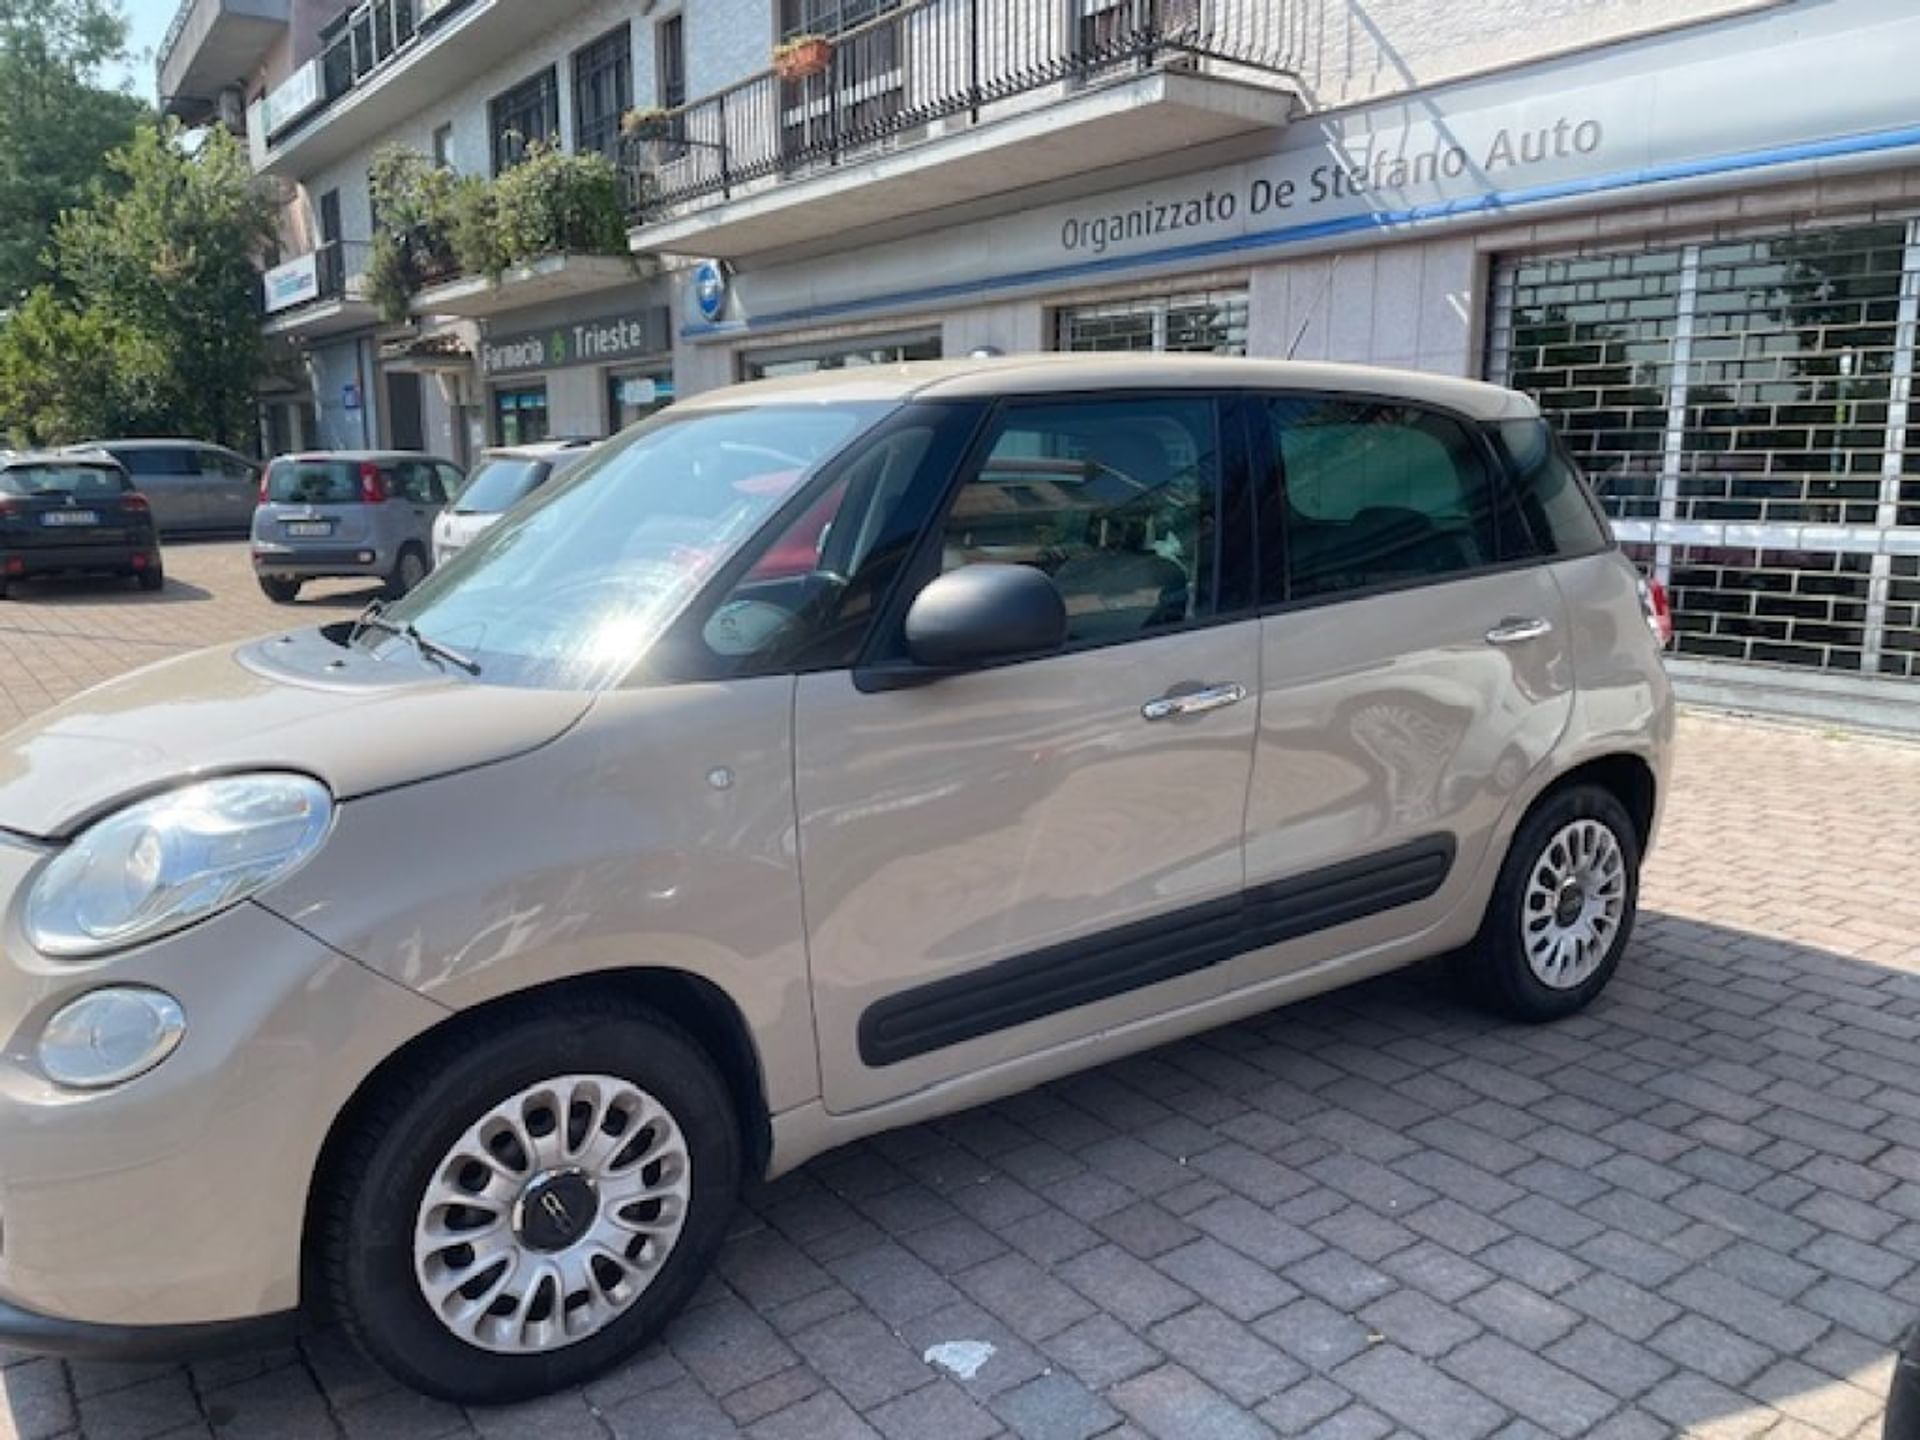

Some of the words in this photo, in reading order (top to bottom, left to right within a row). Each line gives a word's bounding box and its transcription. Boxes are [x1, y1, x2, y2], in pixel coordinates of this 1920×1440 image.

[1061, 190, 1236, 253] Organizzato
[1250, 179, 1295, 214] De
[1309, 146, 1467, 203] Stefano
[1485, 116, 1603, 172] Auto
[482, 336, 545, 372] Farmacia
[572, 318, 641, 359] Trieste
